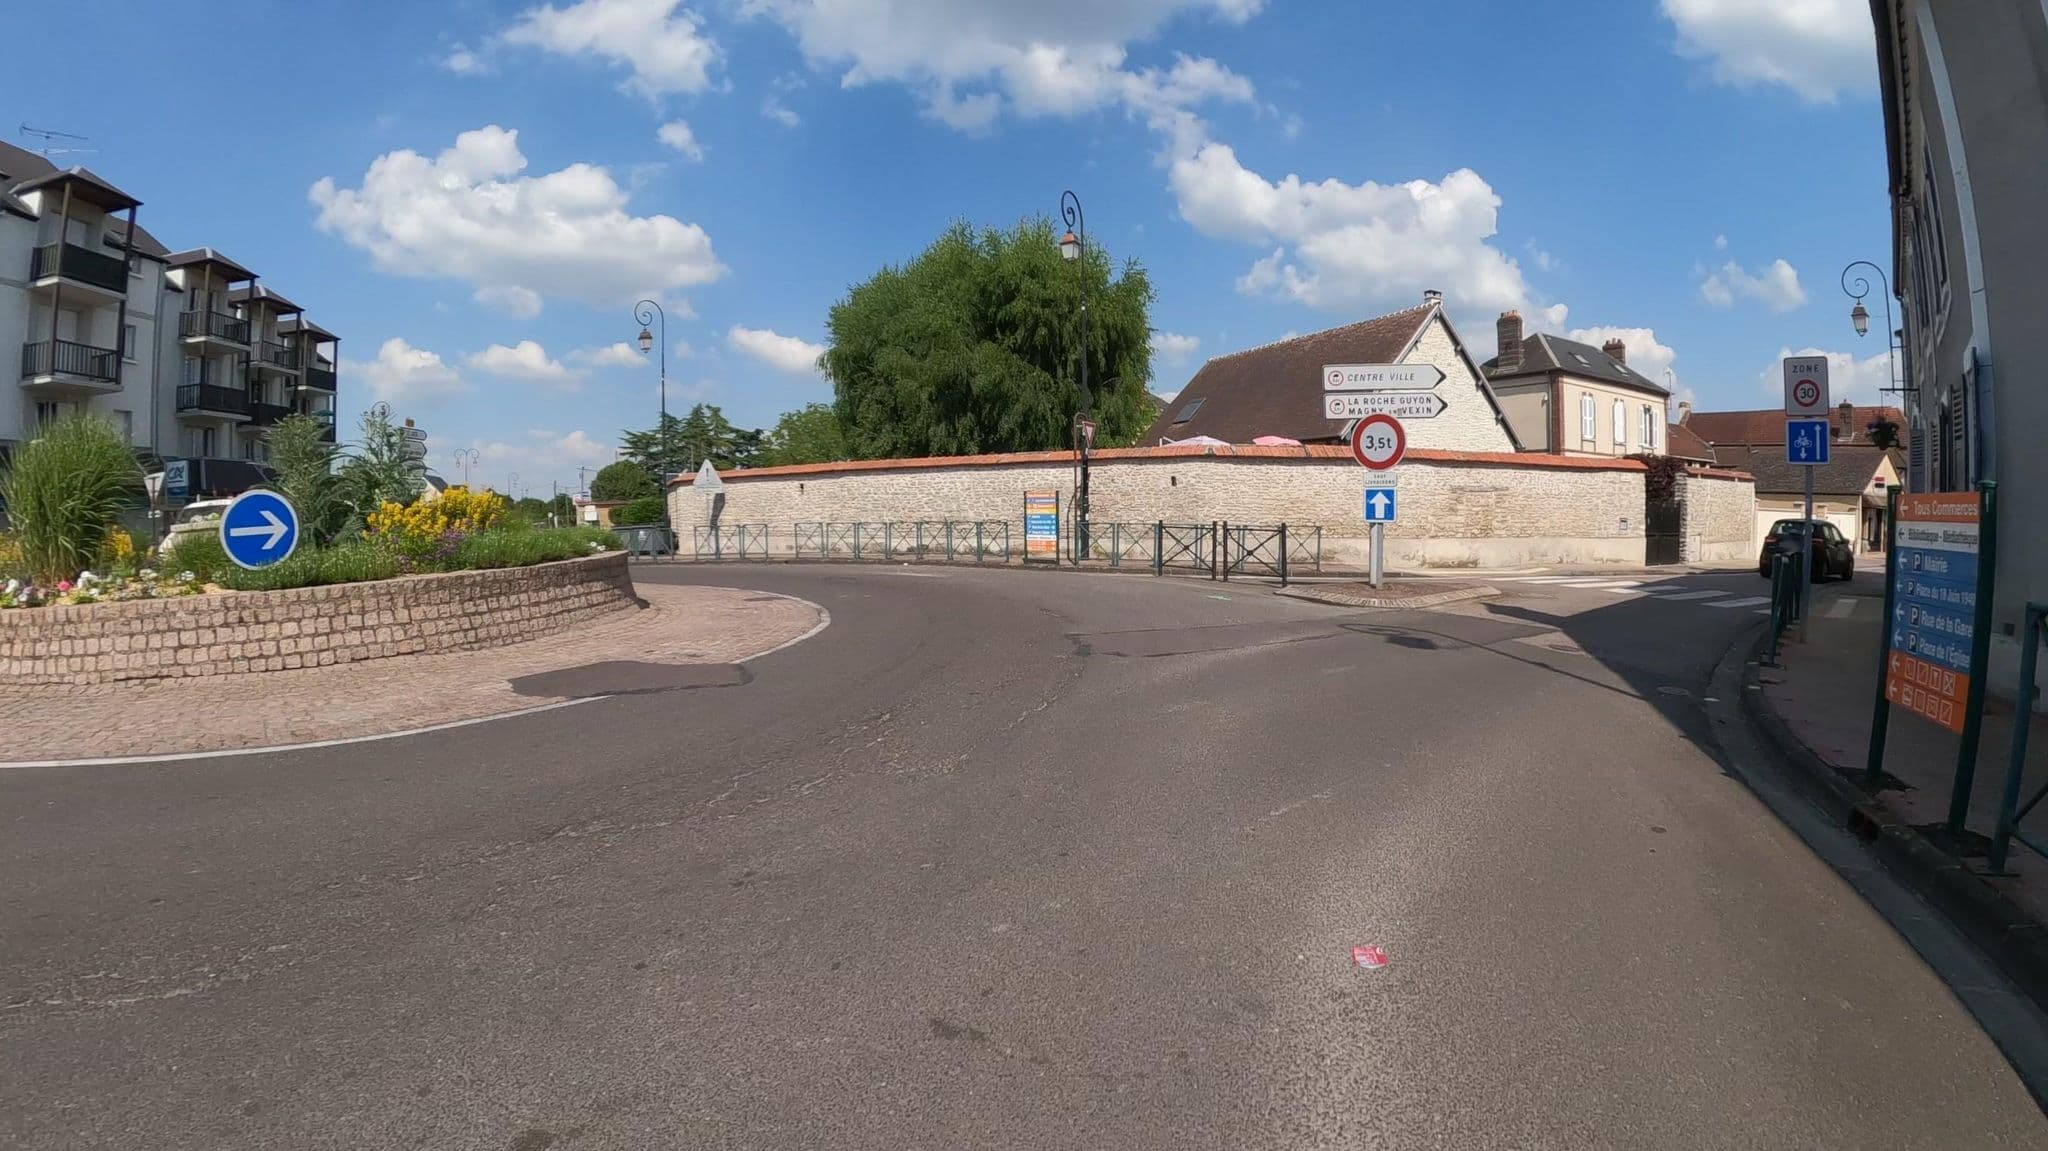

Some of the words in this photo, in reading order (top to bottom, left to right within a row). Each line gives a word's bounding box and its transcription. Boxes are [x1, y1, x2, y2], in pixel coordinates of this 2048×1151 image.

[1792, 364, 1820, 373] ZONE
[1347, 373, 1384, 382] CENTRE
[1389, 373, 1415, 381] VILLE
[1800, 387, 1815, 399] 30
[1348, 398, 1359, 406] LA
[1363, 397, 1396, 405] ROCHE
[1400, 396, 1432, 405] GUYON
[1401, 407, 1432, 415] VEXIN
[1365, 435, 1392, 452] 3,5t
[1914, 501, 1931, 515] Tous
[1931, 500, 1978, 516] Commerces
[1924, 556, 1949, 573] Mairie
[1921, 609, 1935, 627] Rue
[1935, 615, 1945, 630] de
[1945, 617, 1954, 632] la
[1954, 619, 1974, 637] Gare
